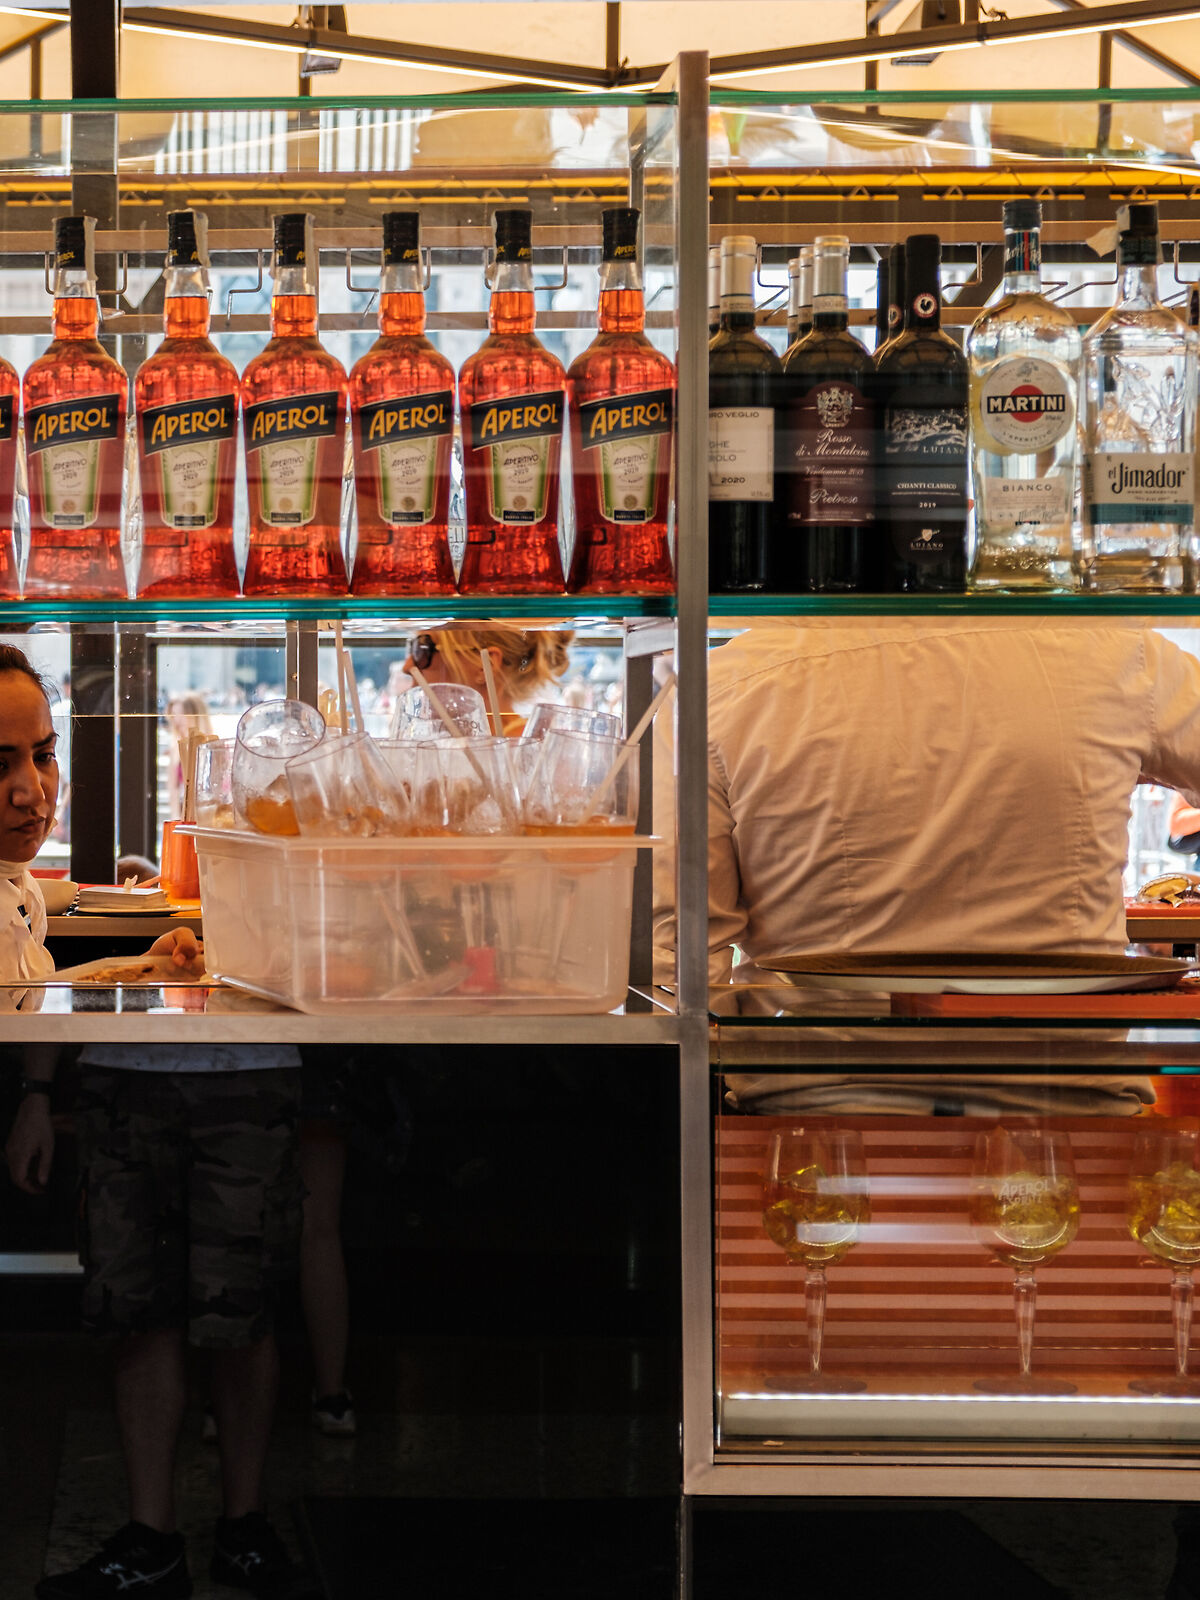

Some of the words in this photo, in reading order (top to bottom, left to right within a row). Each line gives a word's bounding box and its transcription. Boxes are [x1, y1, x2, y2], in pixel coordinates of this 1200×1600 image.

[990, 396, 1063, 412] MARTINI
[33, 408, 111, 444] APEROL
[151, 408, 228, 445] APEROL
[251, 404, 329, 441] APEROL
[368, 404, 446, 441] APEROL
[480, 403, 558, 438] APEROL
[589, 402, 667, 438] APEROL
[796, 445, 807, 456] di
[817, 429, 851, 443] Rosso
[504, 454, 539, 466] APERITIVO
[1003, 484, 1053, 492] BIANCO
[1108, 467, 1116, 479] el
[1112, 463, 1186, 494] Jimador
[999, 1179, 1051, 1200] APEROL
